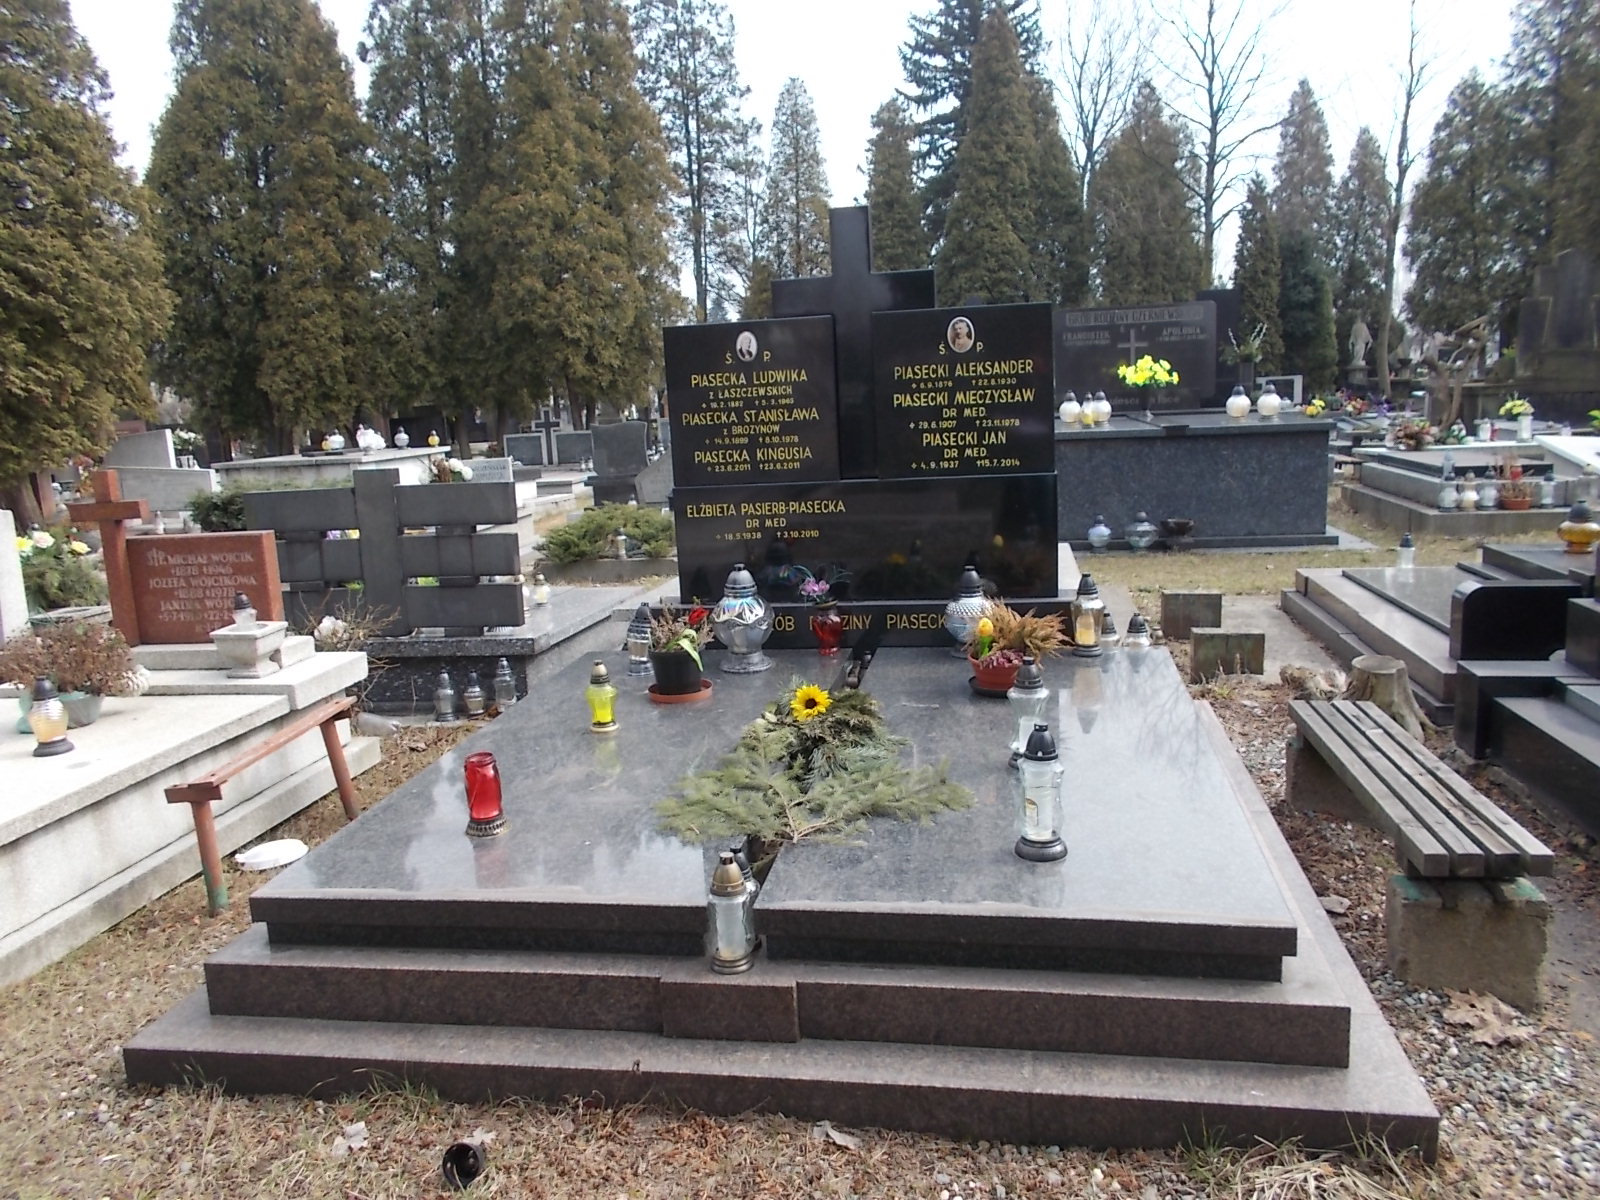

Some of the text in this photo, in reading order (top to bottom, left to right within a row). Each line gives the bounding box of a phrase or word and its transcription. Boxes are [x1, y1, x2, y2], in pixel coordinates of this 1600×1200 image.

[894, 359, 1033, 380] PIASECKI ALEKSANDER
[691, 369, 808, 388] PIASECKA LUDWIKA
[718, 385, 792, 398] ŁASZCZEWSKICH
[893, 389, 1035, 407] PIASECKI MIECZYSŁAW
[682, 408, 819, 426] PIASECKA STANISŁAWA
[943, 408, 956, 417] DR
[923, 431, 1006, 446] PIASECKI JAN
[695, 447, 812, 463] PIASECKA KINGUSIA
[944, 449, 958, 458] DR
[687, 500, 845, 518] ELŻBIETA PASIERB-PIASECKA
[746, 519, 759, 529] DR
[772, 611, 946, 631] ÓB ZINY PIASECK
